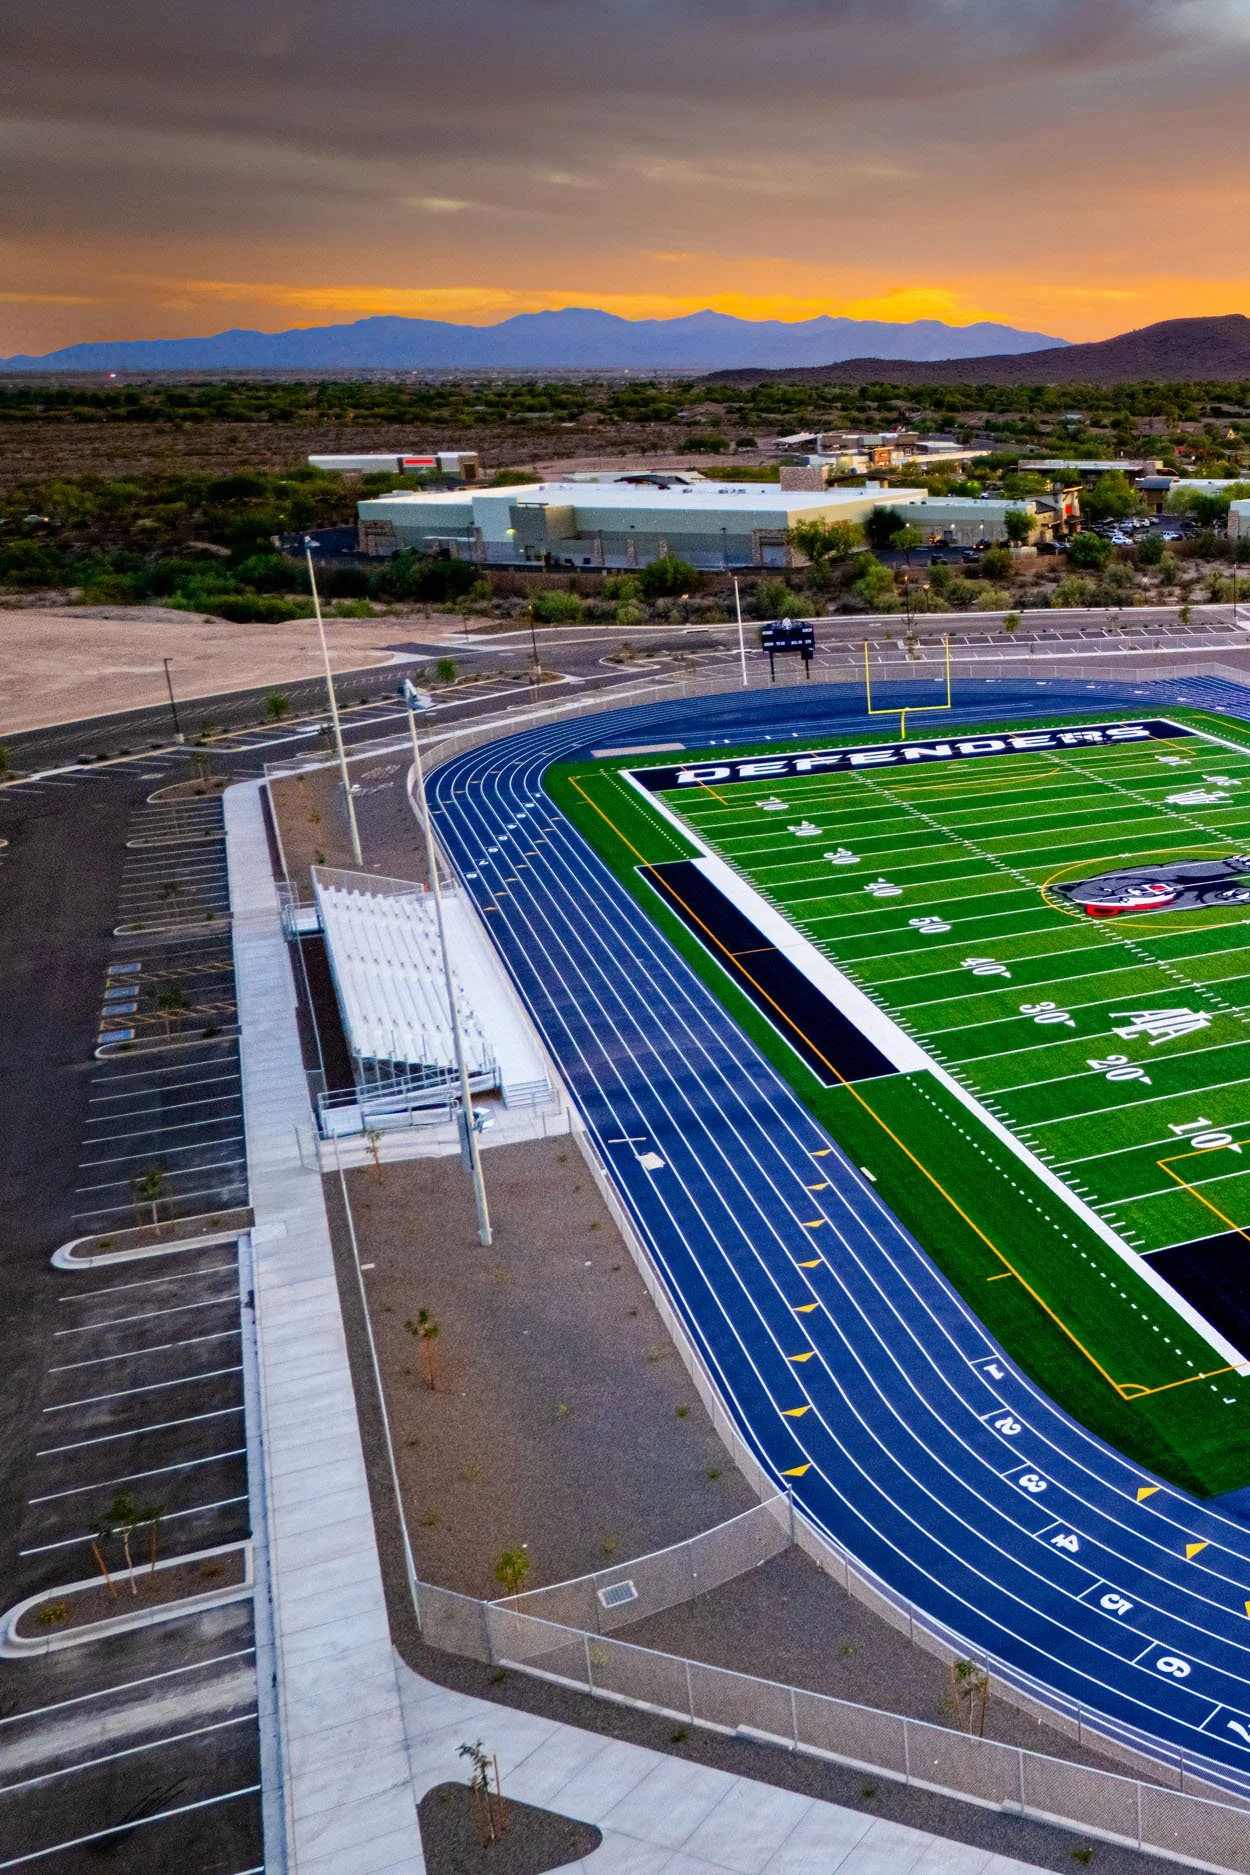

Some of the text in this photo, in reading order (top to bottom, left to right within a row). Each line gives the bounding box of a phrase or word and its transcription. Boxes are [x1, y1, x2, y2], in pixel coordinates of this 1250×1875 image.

[675, 726, 1150, 784] DEFENDERS
[755, 799, 789, 811] 10
[823, 850, 861, 865] 30
[864, 882, 903, 897] 40
[908, 916, 952, 934] 50
[960, 957, 1007, 976] 40
[1019, 1002, 1070, 1024] 30
[1086, 1055, 1144, 1081] 20
[1167, 1116, 1233, 1149] 10
[983, 1364, 1005, 1380] 1
[994, 1416, 1021, 1435] 2
[1018, 1474, 1047, 1493] 3
[1050, 1534, 1080, 1553] 4
[1100, 1593, 1134, 1616] 5
[1156, 1656, 1191, 1678] 6
